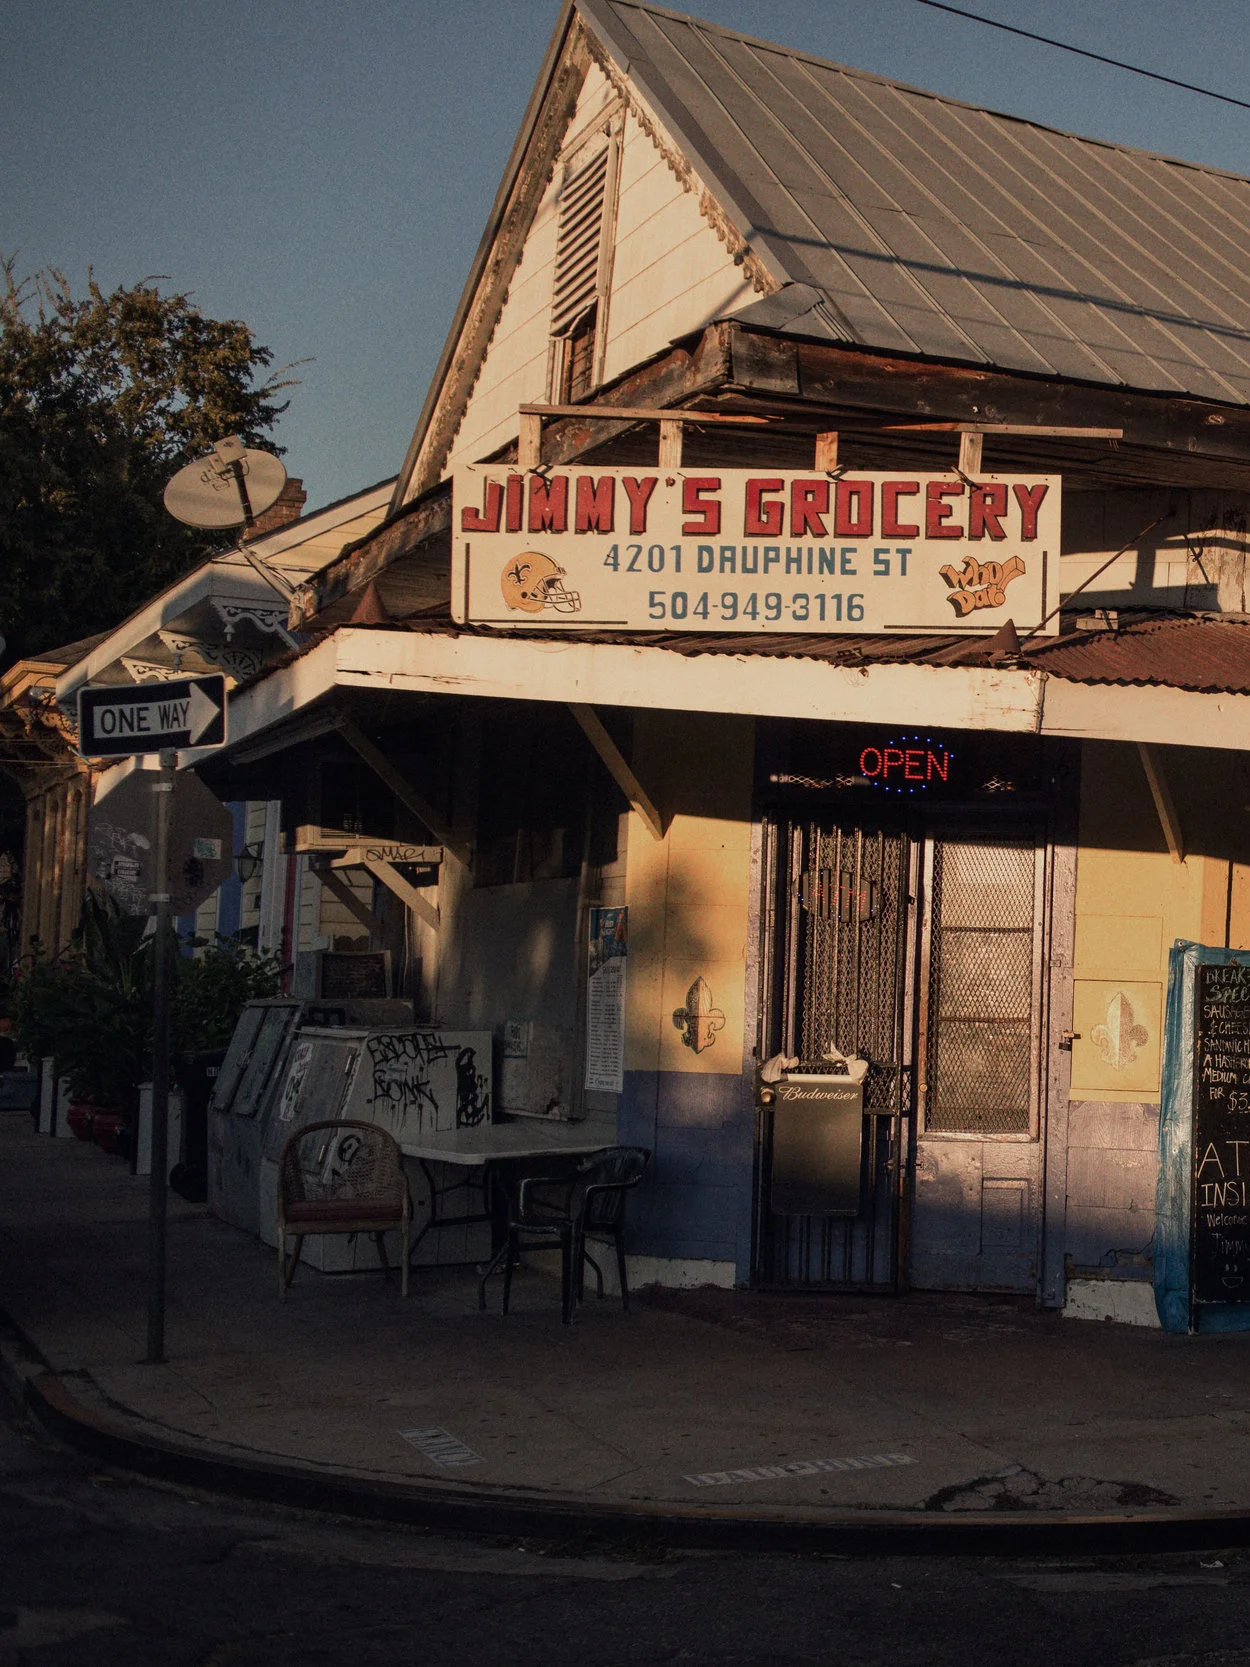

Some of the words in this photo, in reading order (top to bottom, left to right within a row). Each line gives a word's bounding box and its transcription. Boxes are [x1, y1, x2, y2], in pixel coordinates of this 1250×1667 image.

[460, 474, 722, 538] JIMMY'S
[744, 478, 1050, 542] GROCERY
[603, 544, 683, 573] 4201
[697, 545, 858, 576] DAUPHINE
[872, 547, 914, 577] ST
[648, 590, 866, 622] 504-949-3116
[101, 707, 151, 735] ONE
[158, 701, 190, 730] WAY
[859, 747, 949, 782] OPEN
[1204, 1038, 1250, 1054] SANDWICH
[778, 1085, 859, 1101] Budweiser
[1209, 1086, 1226, 1100] FOR
